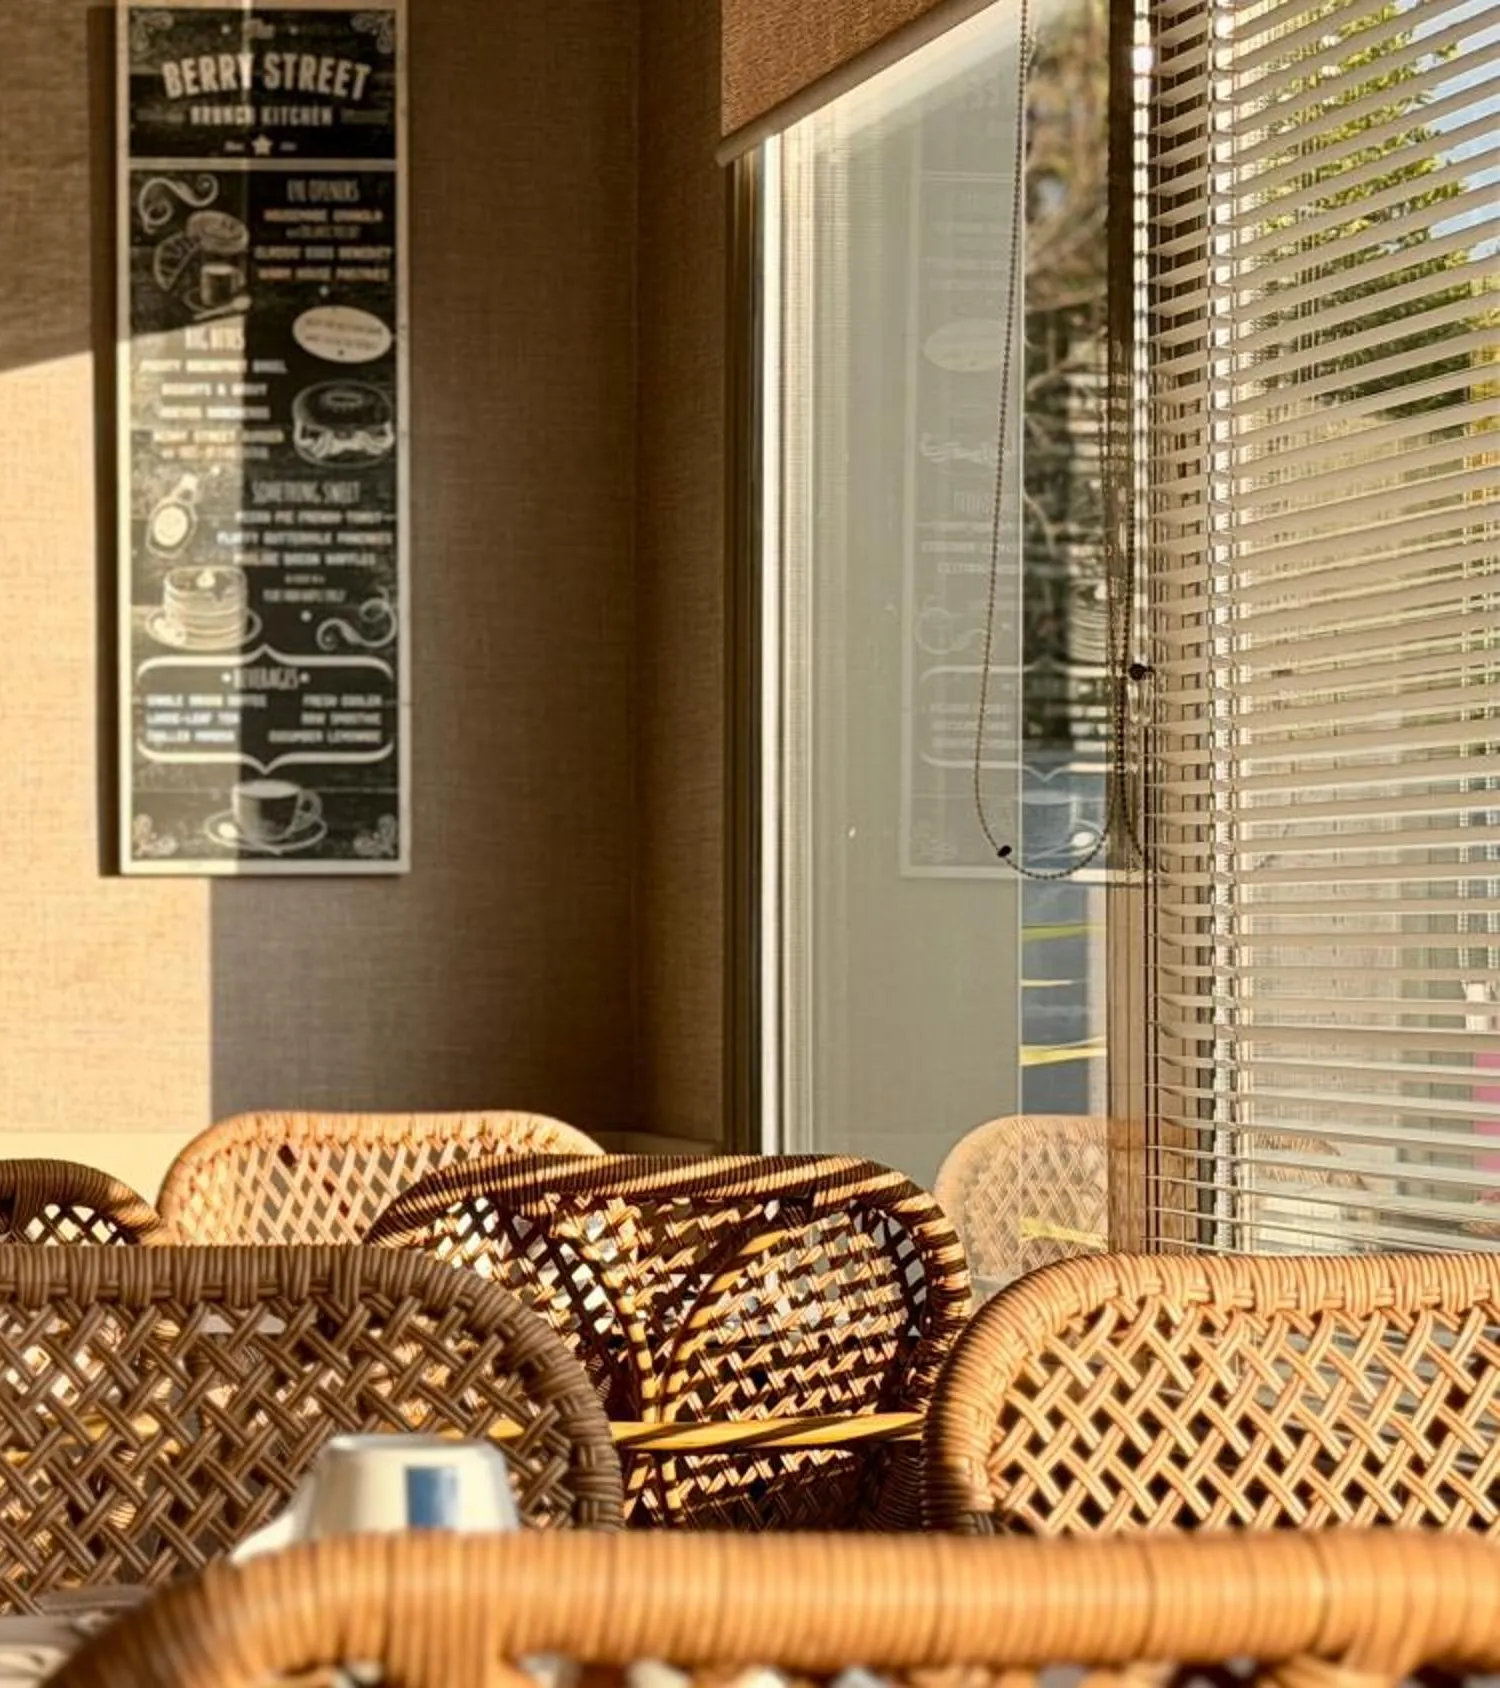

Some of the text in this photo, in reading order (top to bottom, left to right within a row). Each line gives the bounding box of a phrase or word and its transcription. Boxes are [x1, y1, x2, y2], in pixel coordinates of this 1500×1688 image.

[161, 53, 371, 99] BERRY STREET
[190, 105, 332, 126] BRUNCH KITCHEN
